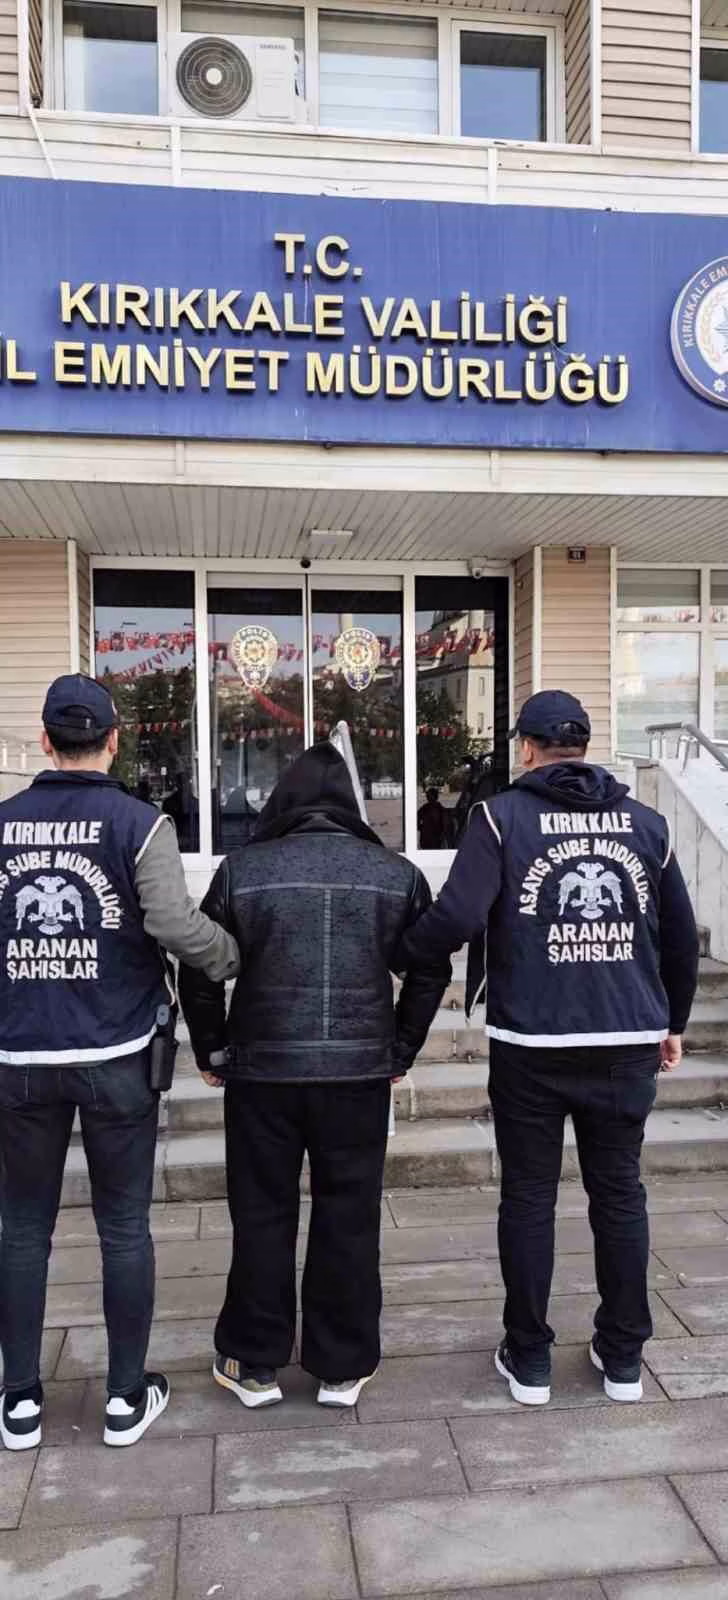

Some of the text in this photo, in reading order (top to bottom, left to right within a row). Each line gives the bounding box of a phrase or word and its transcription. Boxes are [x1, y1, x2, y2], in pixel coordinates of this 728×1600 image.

[274, 232, 363, 278] T.C.
[59, 281, 568, 345] KIRIKKALE VALİLİĞİ
[0, 337, 629, 405] L EMNİYET MÜDÜRLÜĞÜ
[2, 821, 102, 845] KIRIKKALE
[540, 811, 633, 834] KIRIKKALE
[547, 922, 634, 943] ARANAN
[6, 938, 98, 958] ARANAN
[548, 942, 634, 966] ŞAHISLAR
[7, 960, 98, 984] ŞAHISLAR
